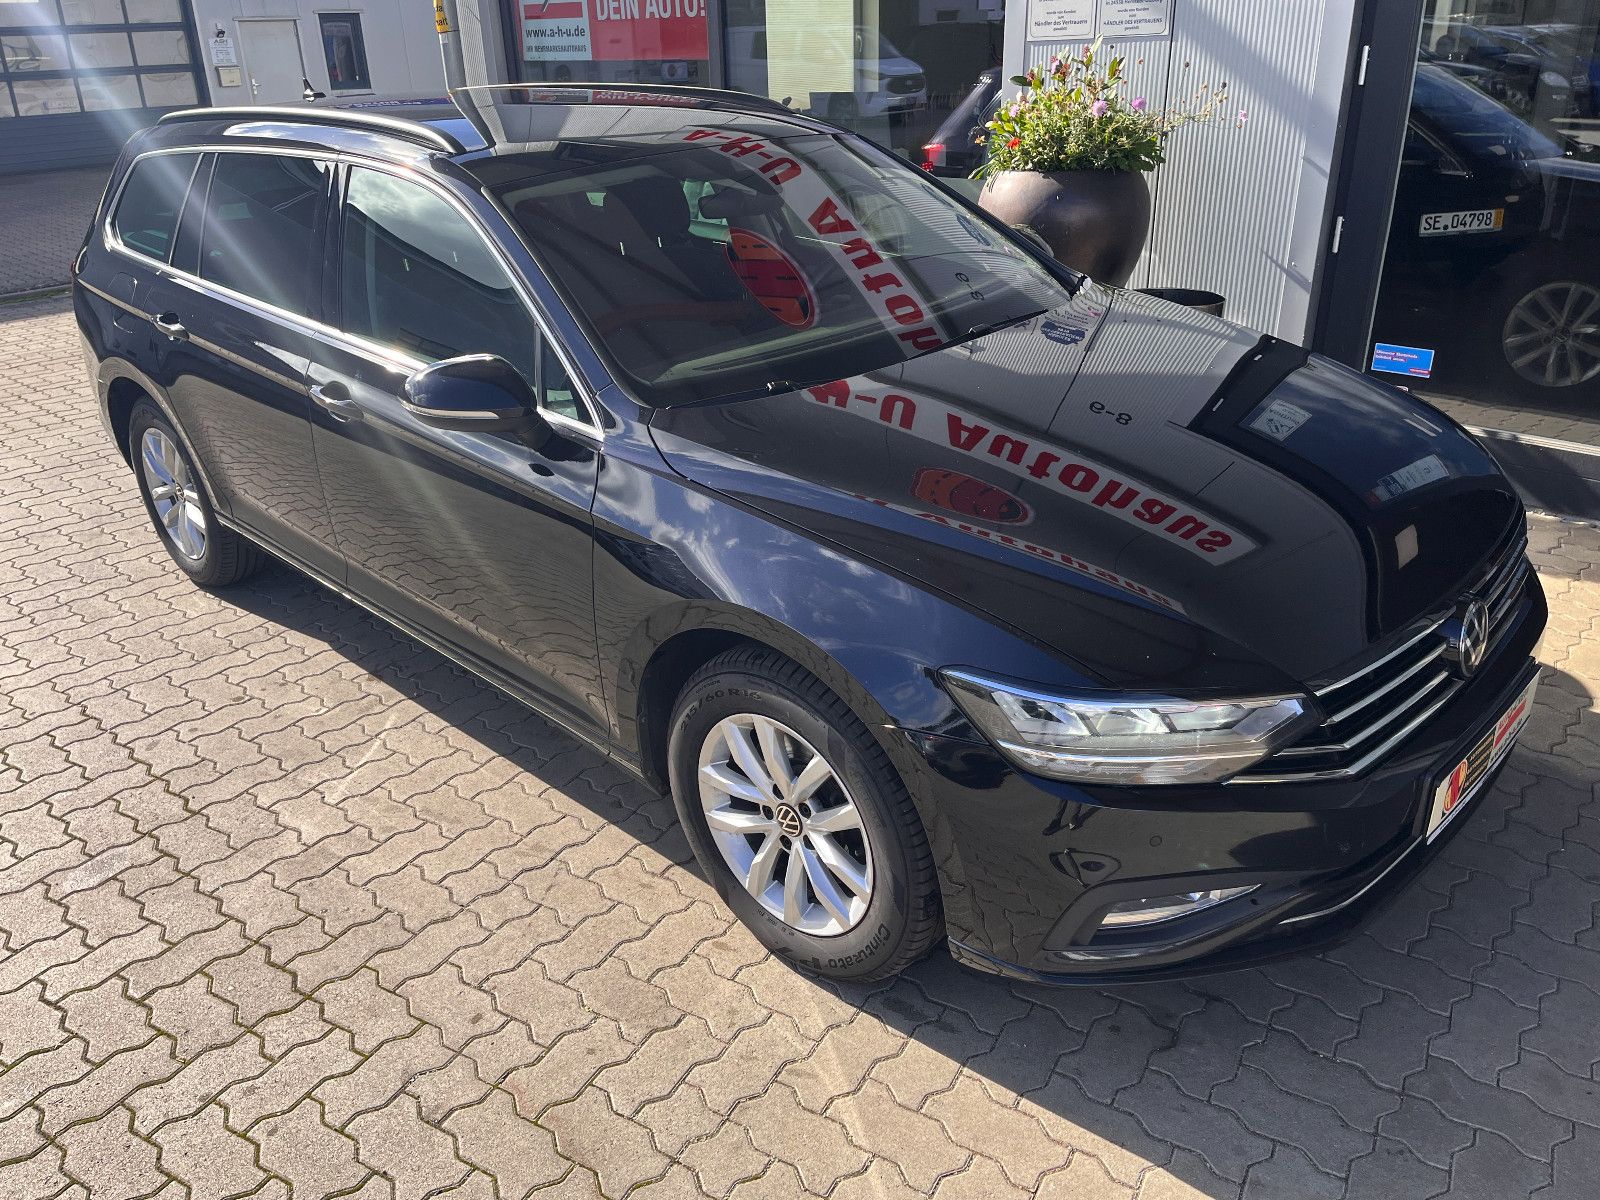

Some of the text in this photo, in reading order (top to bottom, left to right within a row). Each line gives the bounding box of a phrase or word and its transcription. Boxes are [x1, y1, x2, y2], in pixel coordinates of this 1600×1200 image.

[595, 0, 706, 21] DEIN AUTO!
[525, 26, 586, 38] www.a-h-u.de
[827, 922, 891, 970] Cinturato
